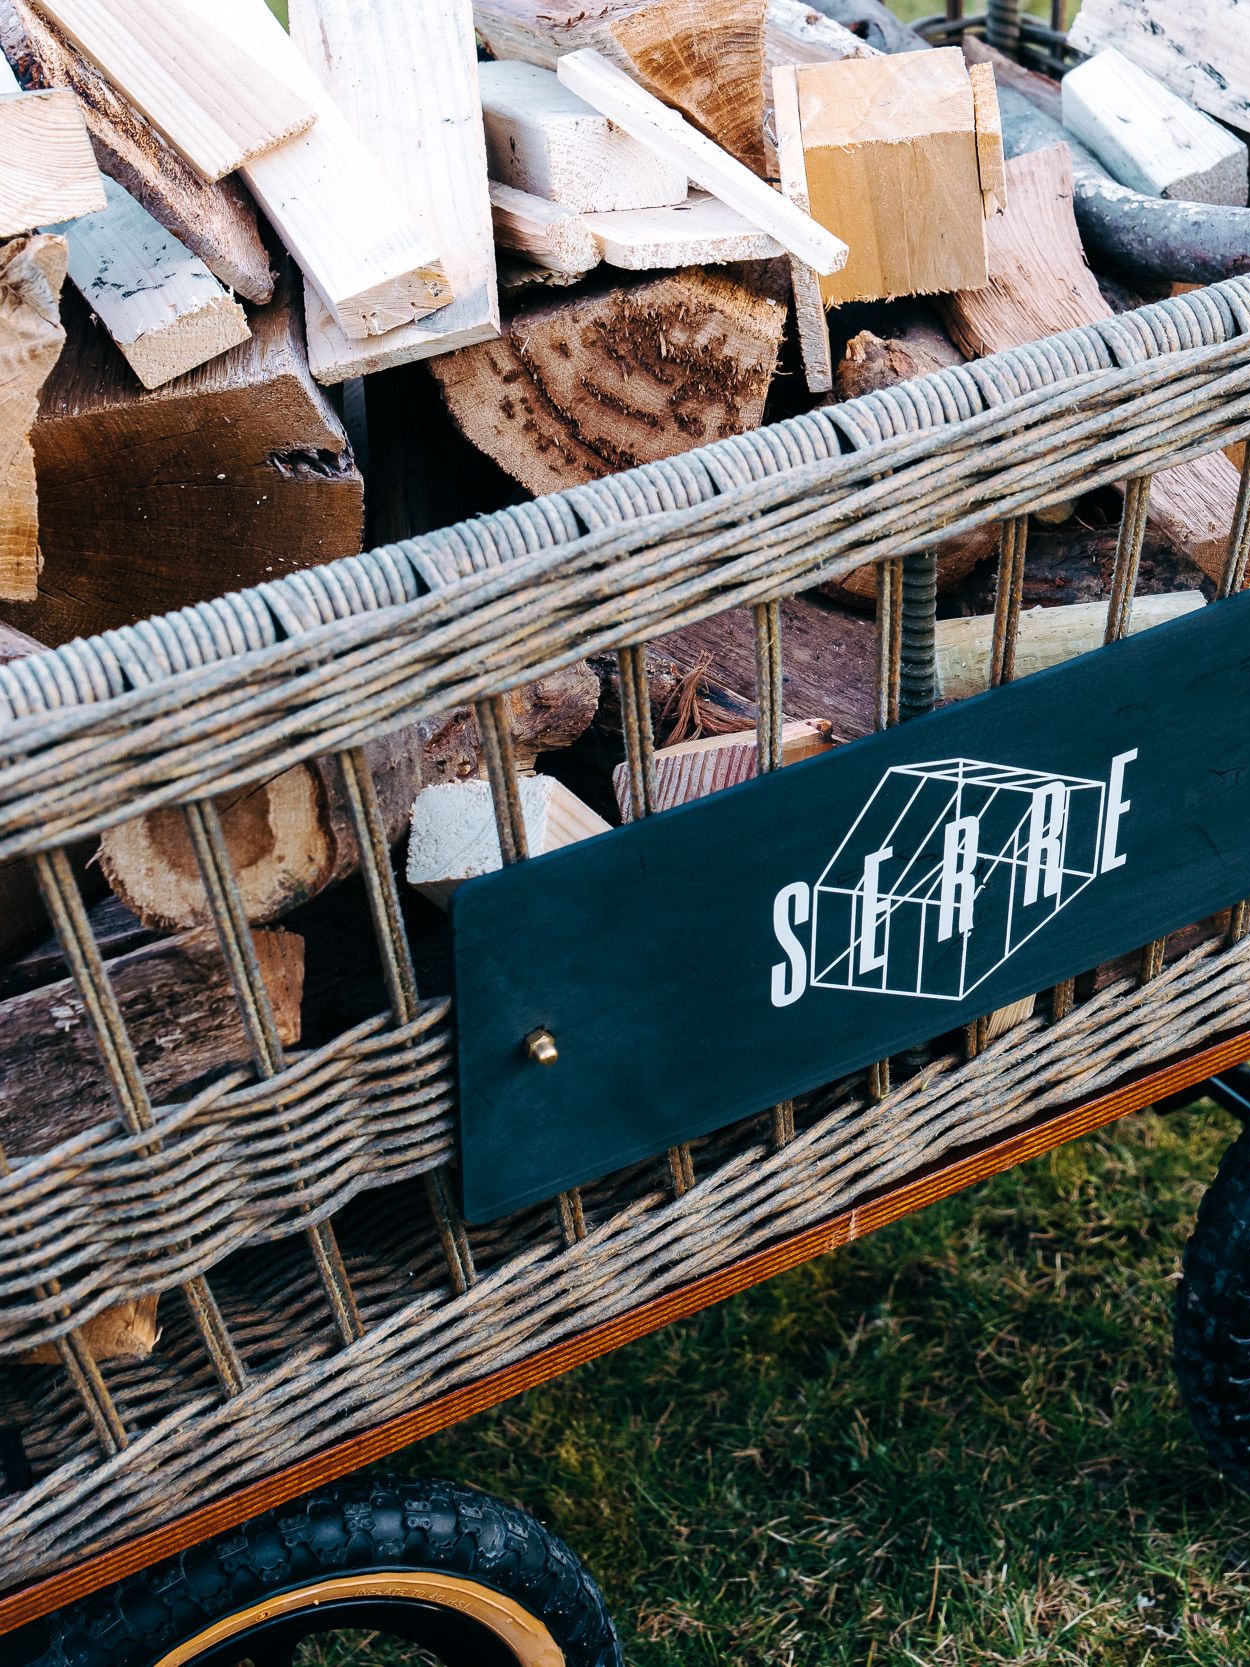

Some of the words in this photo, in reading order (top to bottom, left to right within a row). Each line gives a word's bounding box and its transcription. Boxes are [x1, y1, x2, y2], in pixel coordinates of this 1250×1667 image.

[770, 747, 1139, 1008] SERRE
[355, 1587, 408, 1596] INFLATE
[412, 1589, 426, 1597] TO
